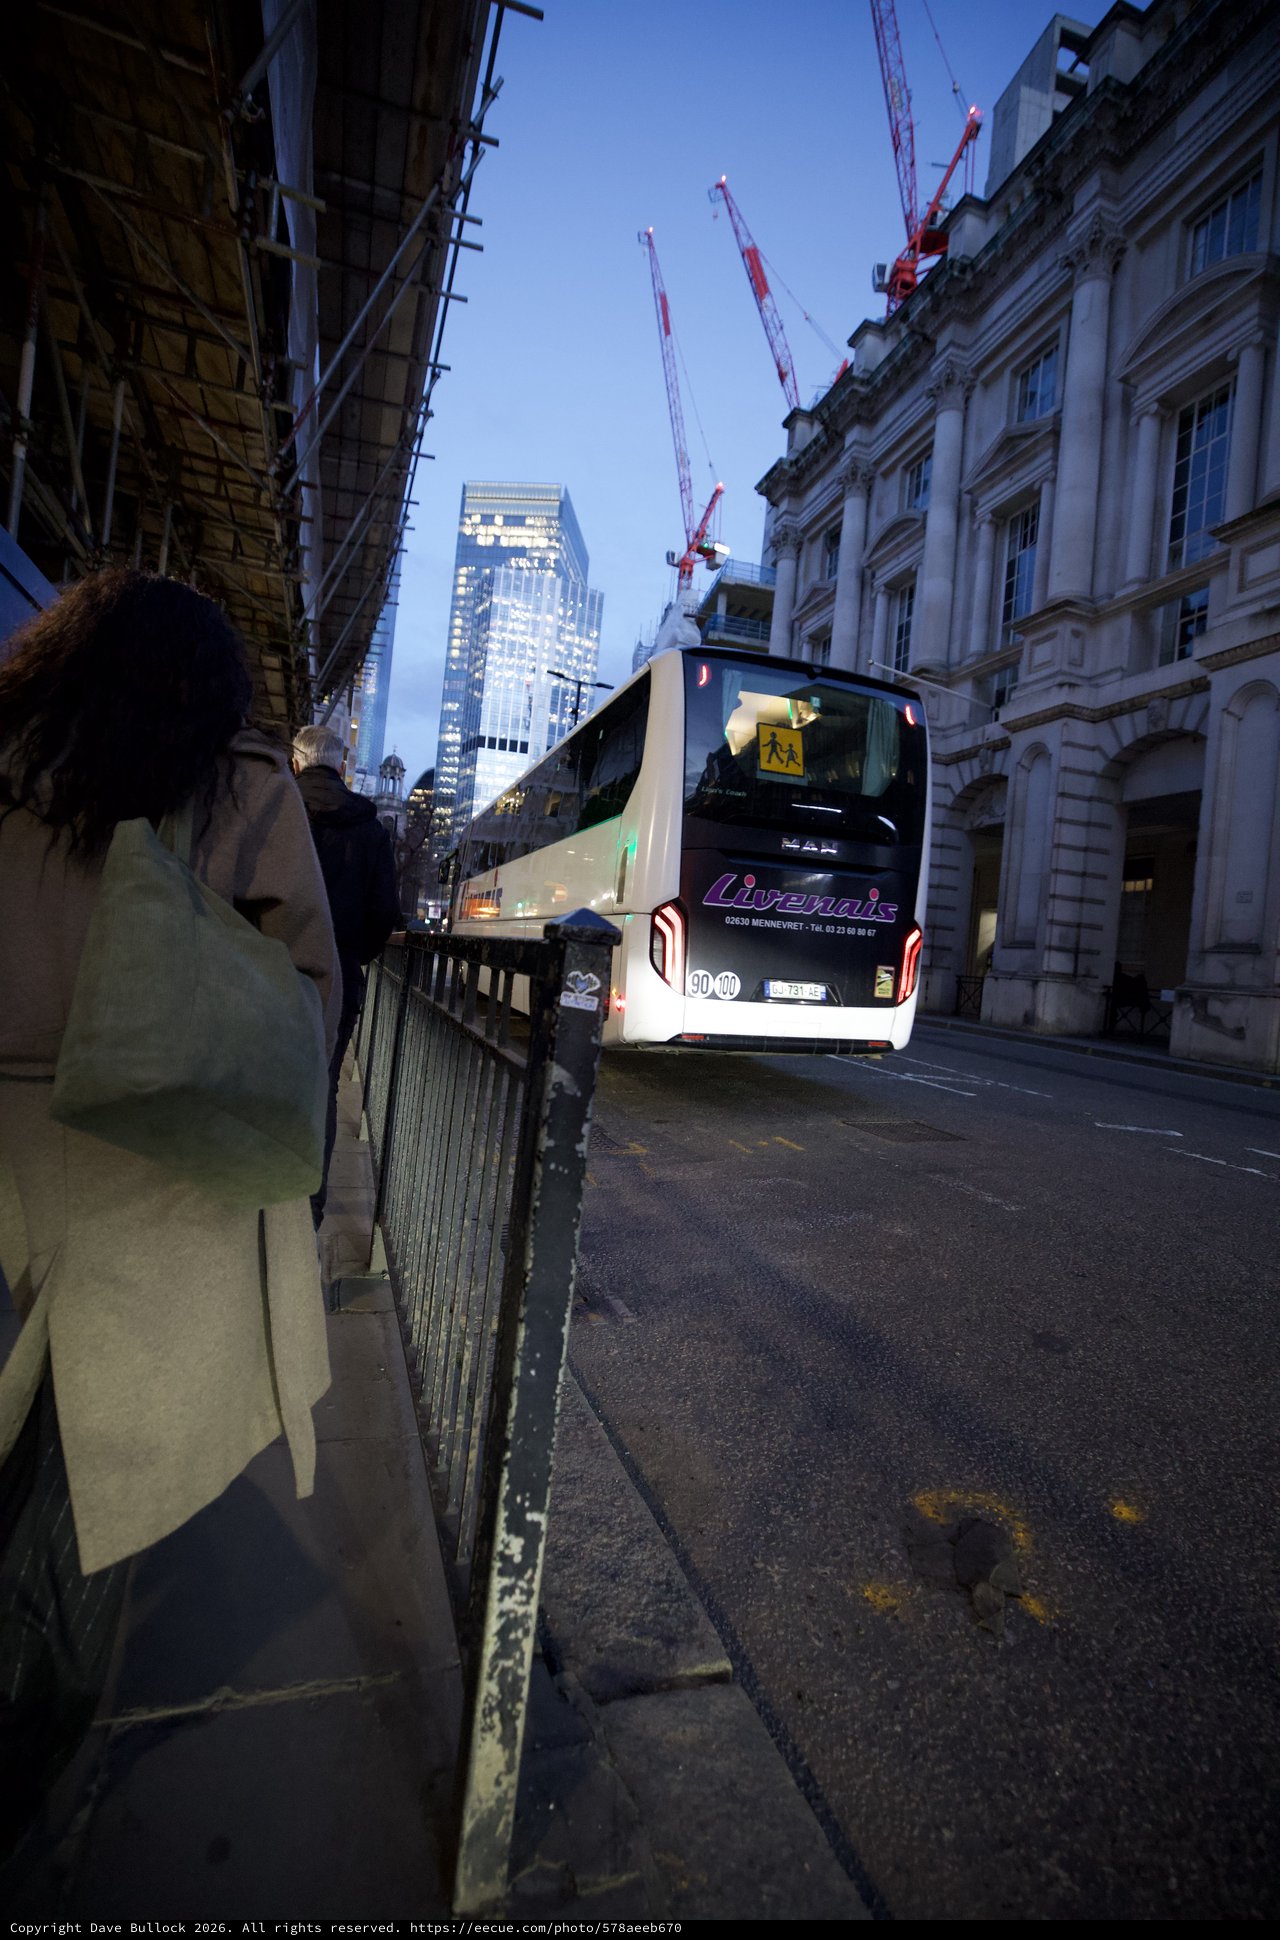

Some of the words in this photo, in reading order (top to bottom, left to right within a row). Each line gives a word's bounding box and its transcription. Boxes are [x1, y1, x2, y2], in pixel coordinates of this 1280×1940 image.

[781, 837, 838, 856] MAN
[702, 873, 898, 923] Livenais
[725, 916, 750, 926] 02630
[751, 918, 804, 931] MENNEVRET
[811, 923, 824, 933] Tél.
[825, 925, 835, 934] 03
[836, 926, 846, 935] 23
[847, 927, 856, 936] 60
[857, 928, 866, 937] 80
[867, 928, 877, 938] 67
[691, 973, 710, 995] 90
[719, 974, 736, 996] 100
